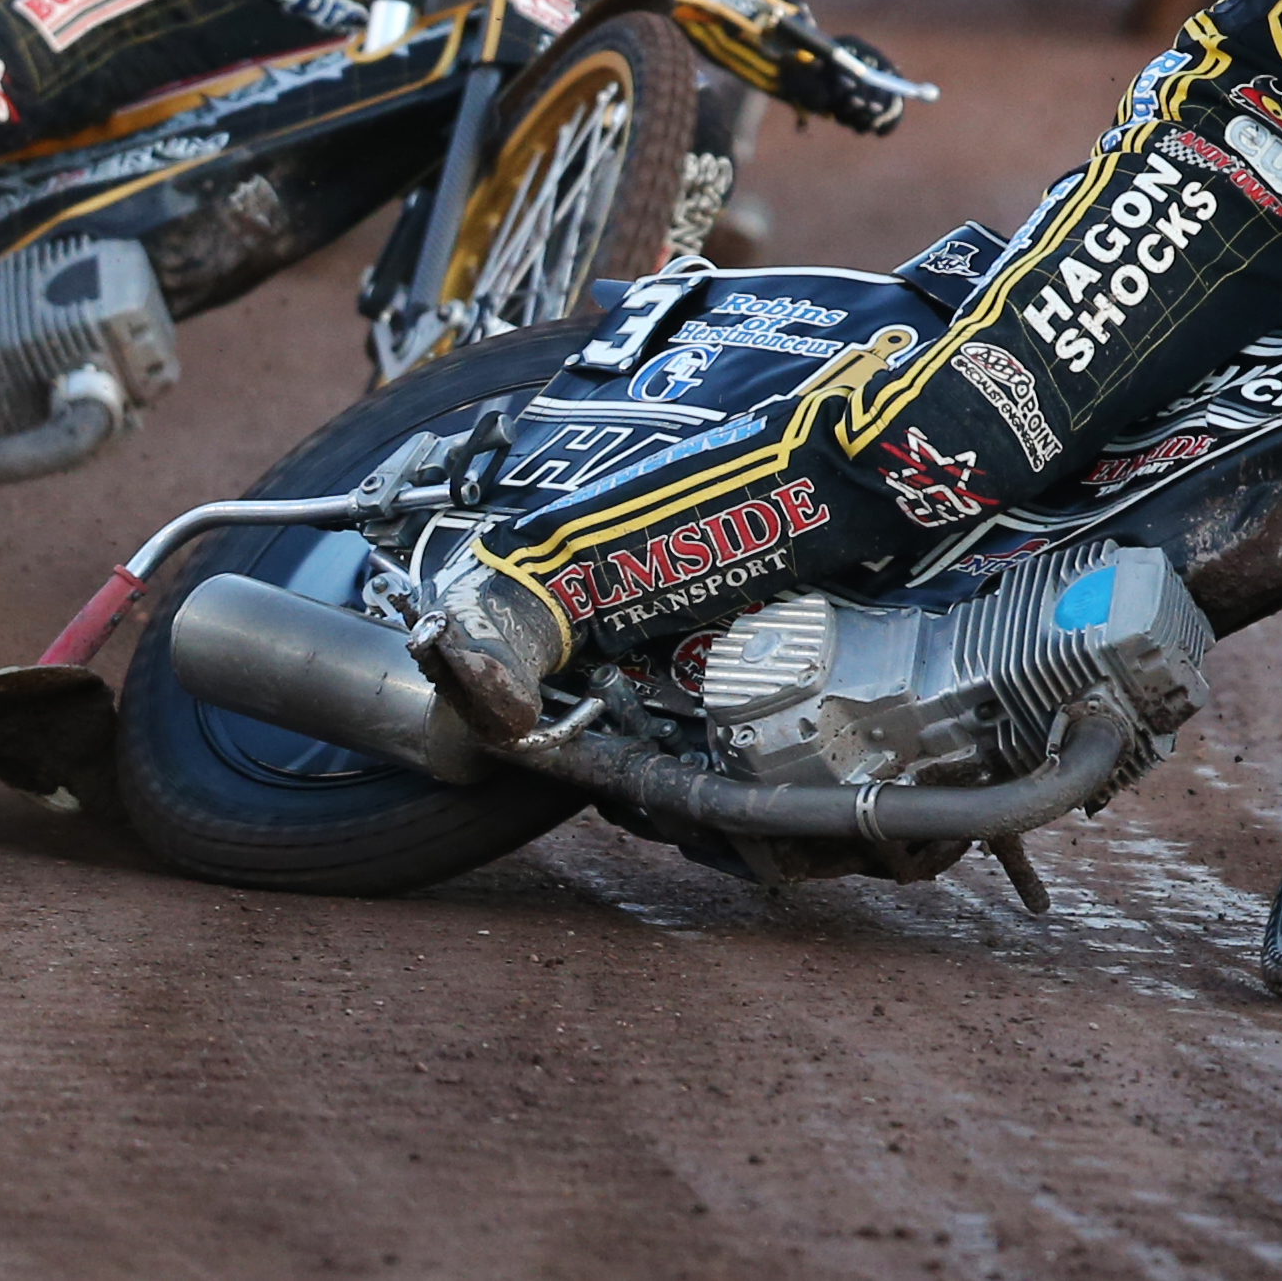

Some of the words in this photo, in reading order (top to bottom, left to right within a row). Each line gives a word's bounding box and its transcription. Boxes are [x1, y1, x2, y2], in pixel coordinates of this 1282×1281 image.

[1176, 129, 1235, 170] ANDY
[1023, 152, 1182, 344] HAGON
[1056, 182, 1218, 373] SHOCKS
[585, 283, 685, 367] 3
[669, 321, 846, 358] Herstmonceux
[714, 293, 849, 327] Robins
[745, 316, 788, 336] of
[953, 356, 1004, 405] SPECIALIST
[546, 478, 830, 623] ELMSIDE
[604, 549, 788, 632] TRANSPORT
